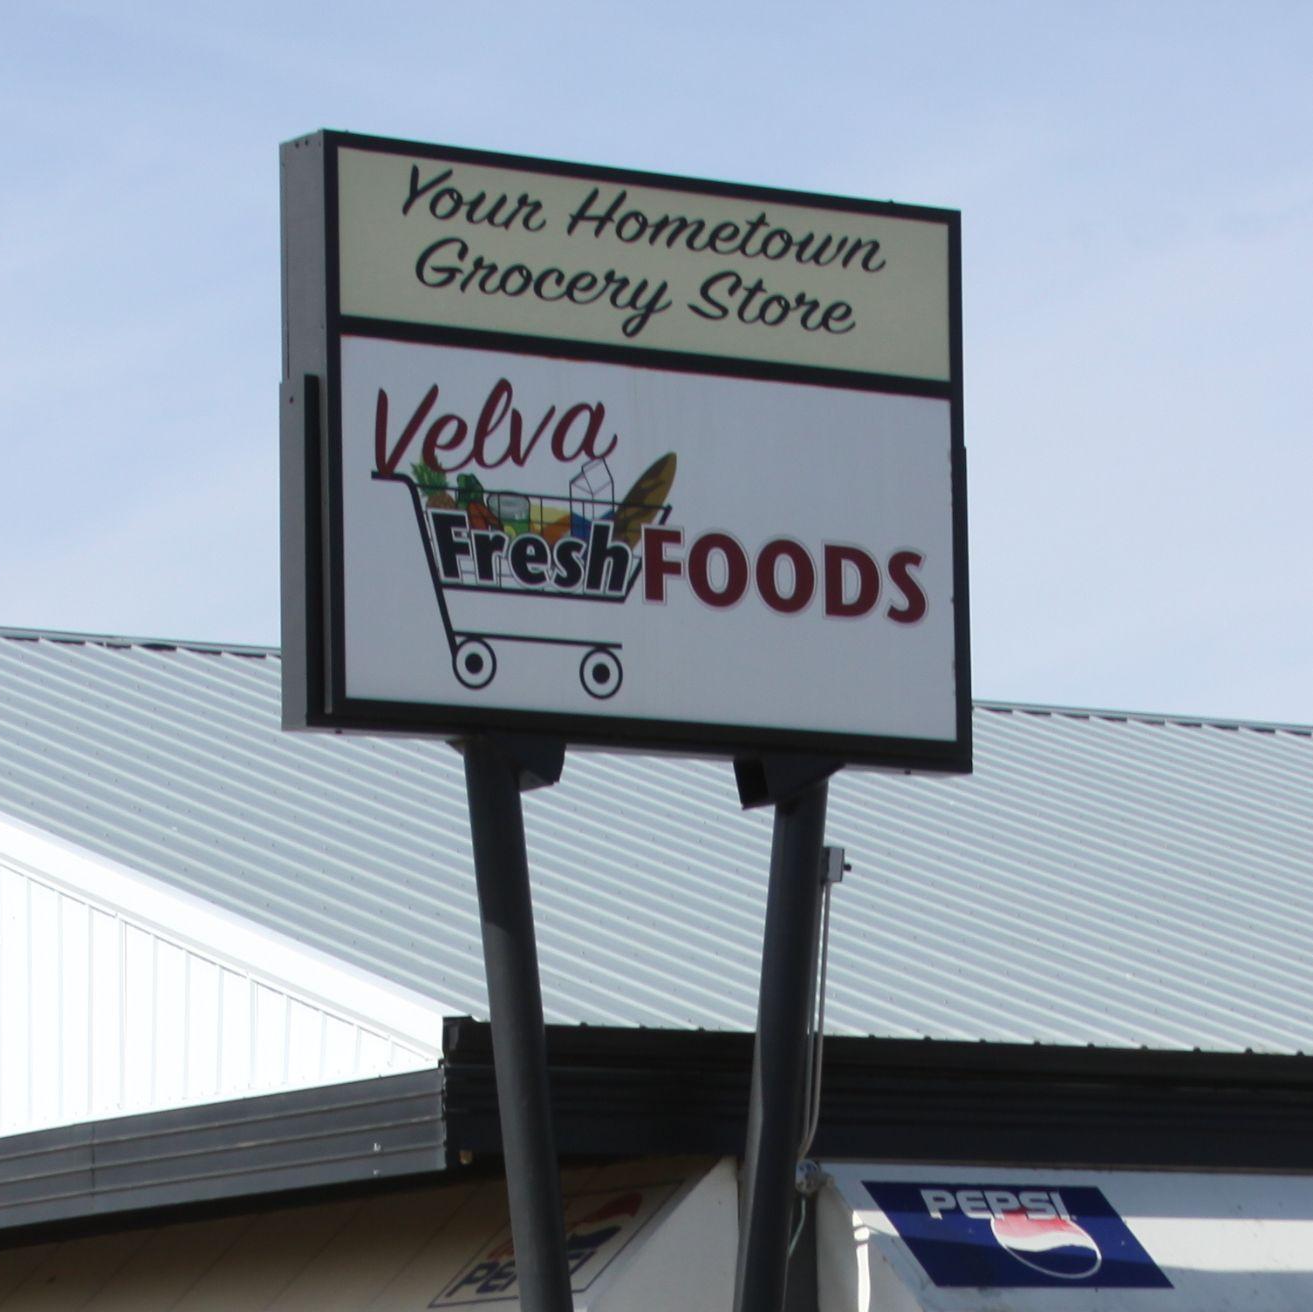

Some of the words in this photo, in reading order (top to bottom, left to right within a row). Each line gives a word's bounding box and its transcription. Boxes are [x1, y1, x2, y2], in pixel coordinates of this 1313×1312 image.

[402, 164, 546, 232] Your
[568, 187, 887, 273] Hometown
[414, 237, 672, 337] Grocery
[689, 270, 856, 335] Store
[374, 377, 618, 475] Velva
[426, 508, 636, 598] Fresh
[639, 522, 929, 627] FOODS
[920, 1188, 1071, 1222] PEPSI
